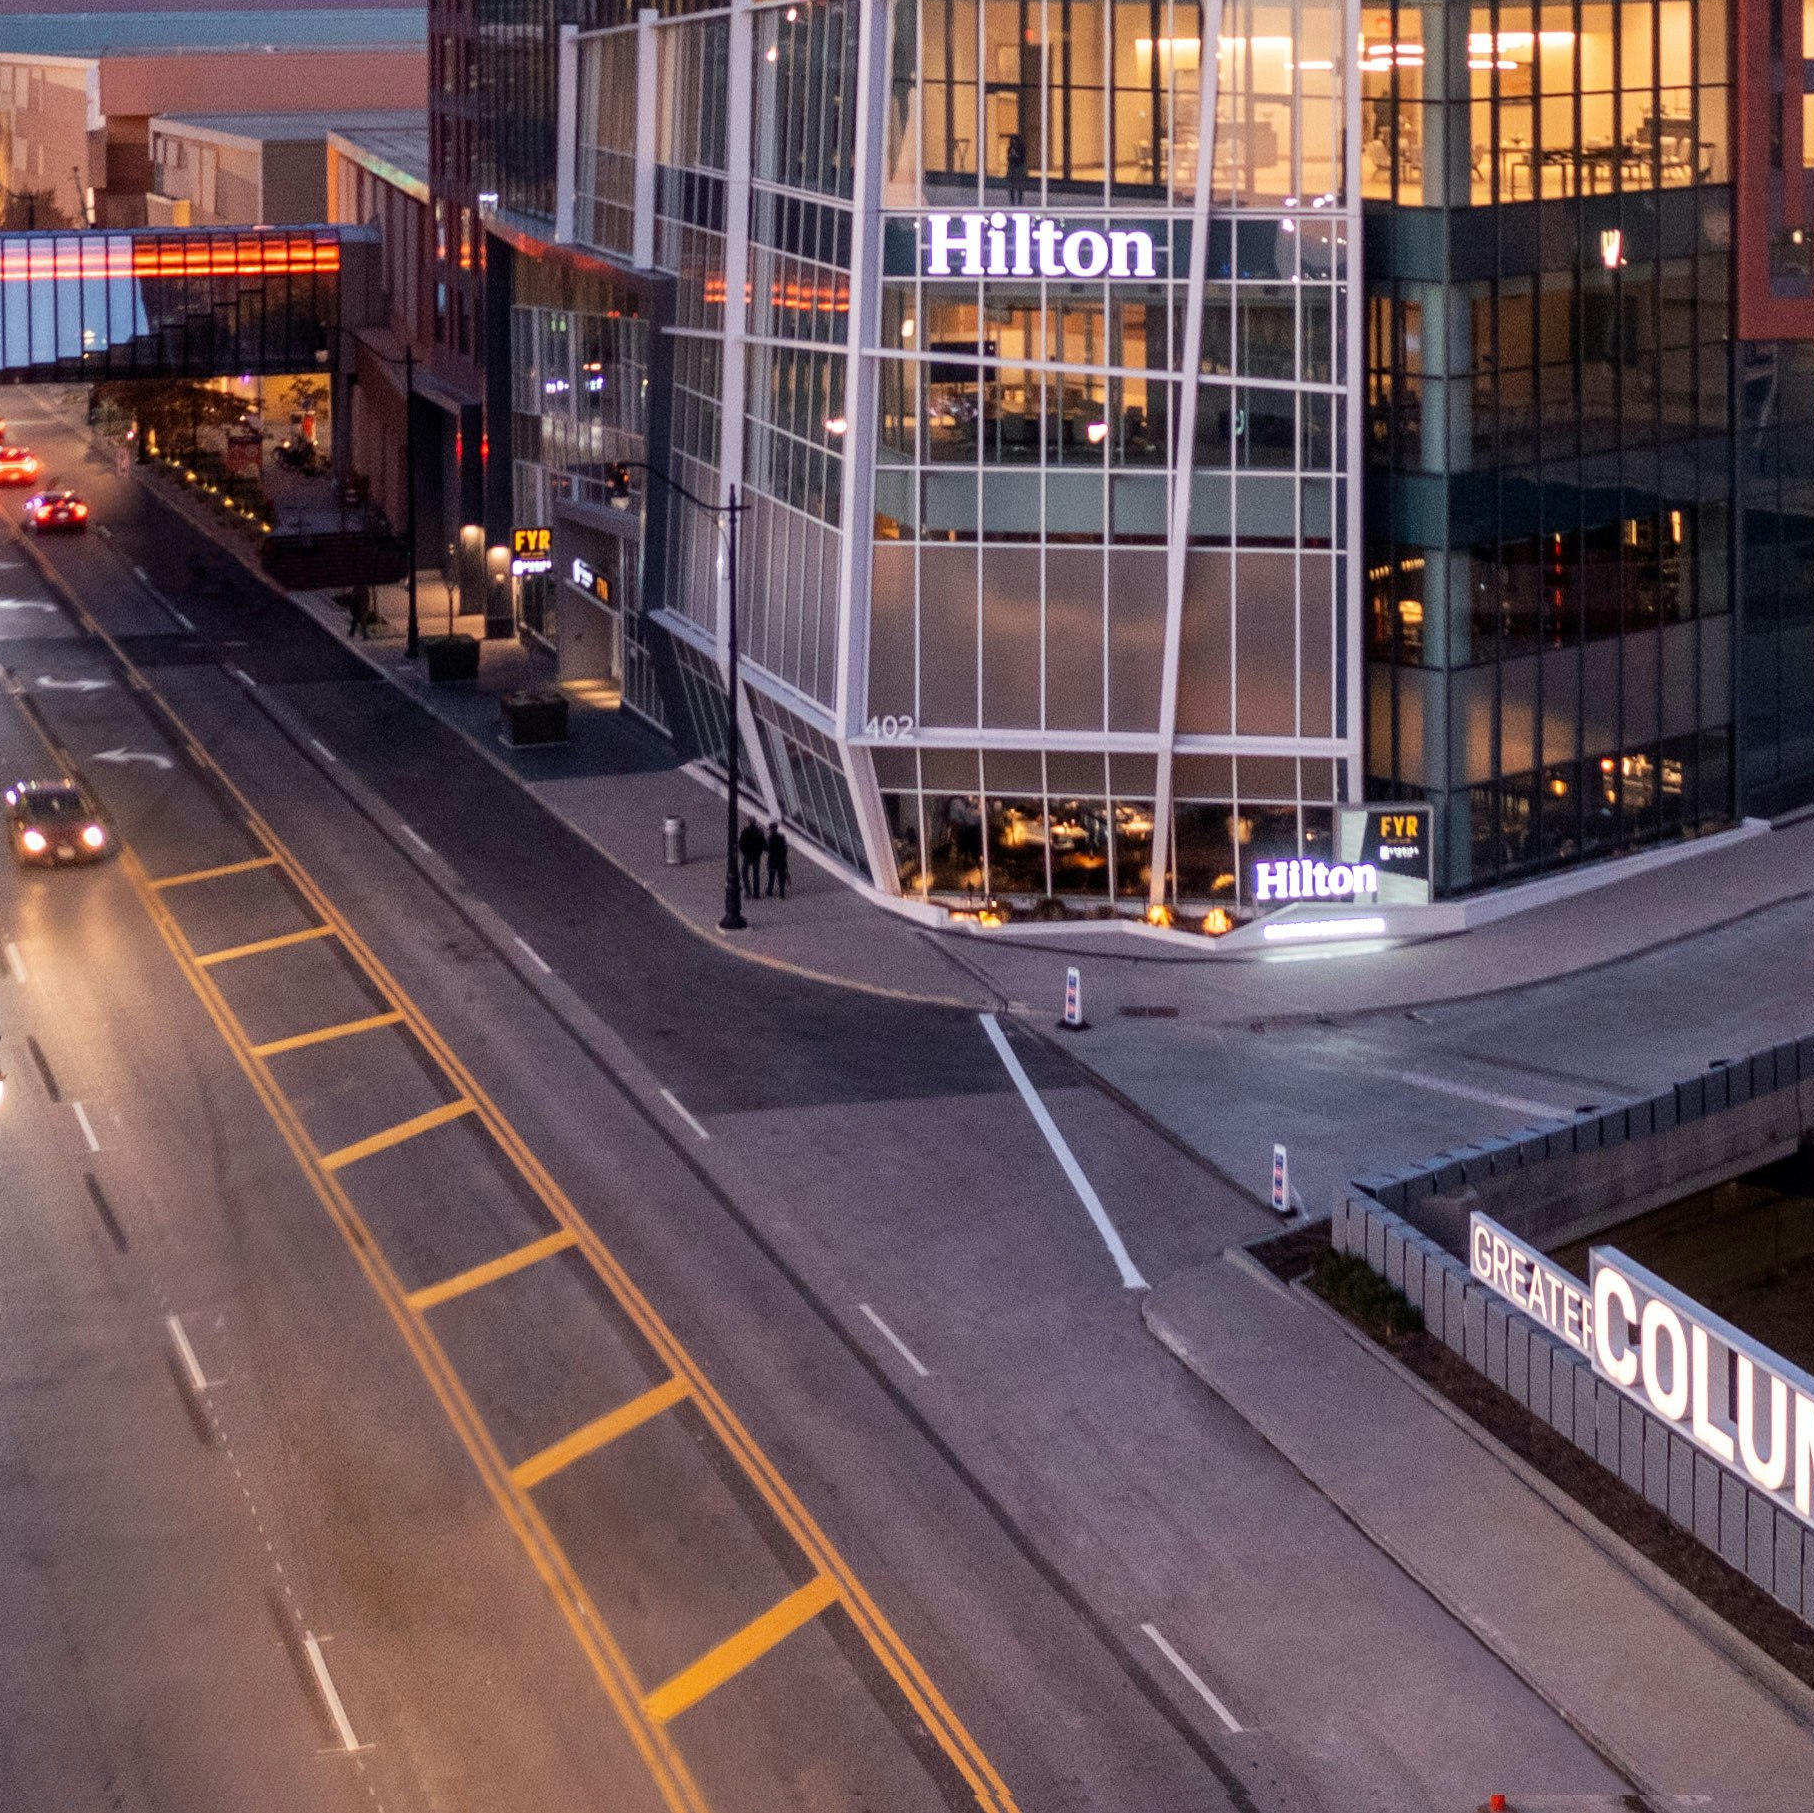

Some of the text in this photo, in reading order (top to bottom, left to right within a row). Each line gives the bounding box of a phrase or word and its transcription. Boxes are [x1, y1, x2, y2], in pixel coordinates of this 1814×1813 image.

[928, 212, 1156, 276] Hilton
[514, 529, 551, 552] FYR
[865, 715, 914, 740] 402
[1380, 815, 1419, 838] FYR
[1255, 859, 1378, 900] Hilton
